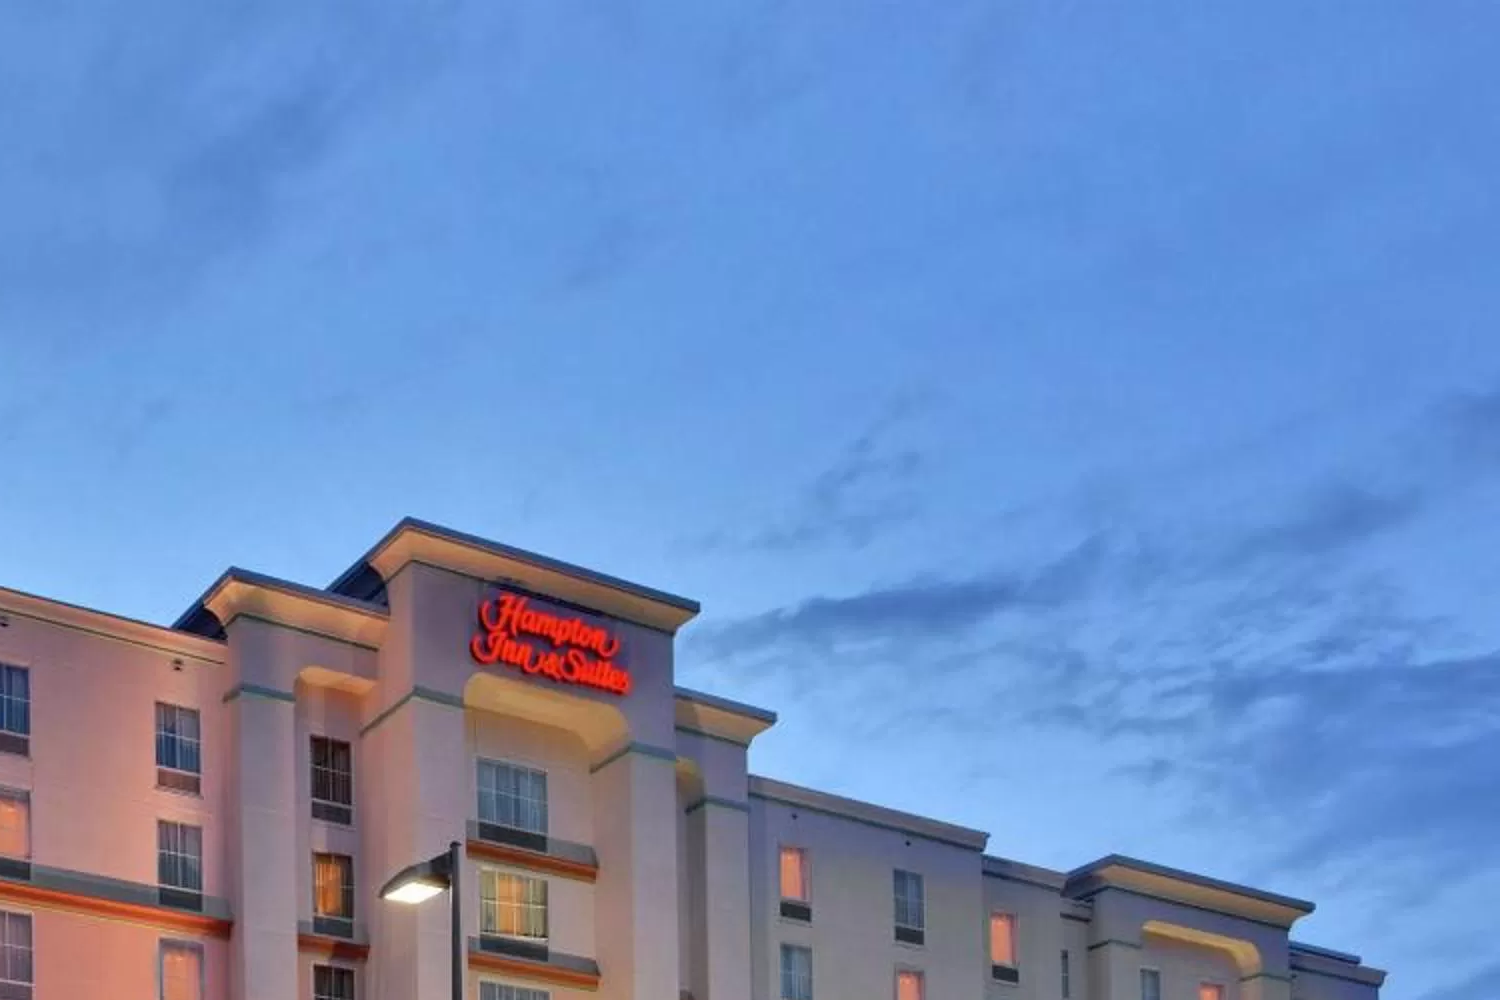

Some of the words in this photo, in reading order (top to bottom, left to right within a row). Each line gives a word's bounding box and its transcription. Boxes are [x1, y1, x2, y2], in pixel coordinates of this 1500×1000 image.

[480, 591, 620, 657] Hampton
[472, 630, 540, 673] Inn
[559, 648, 632, 694] Suites
